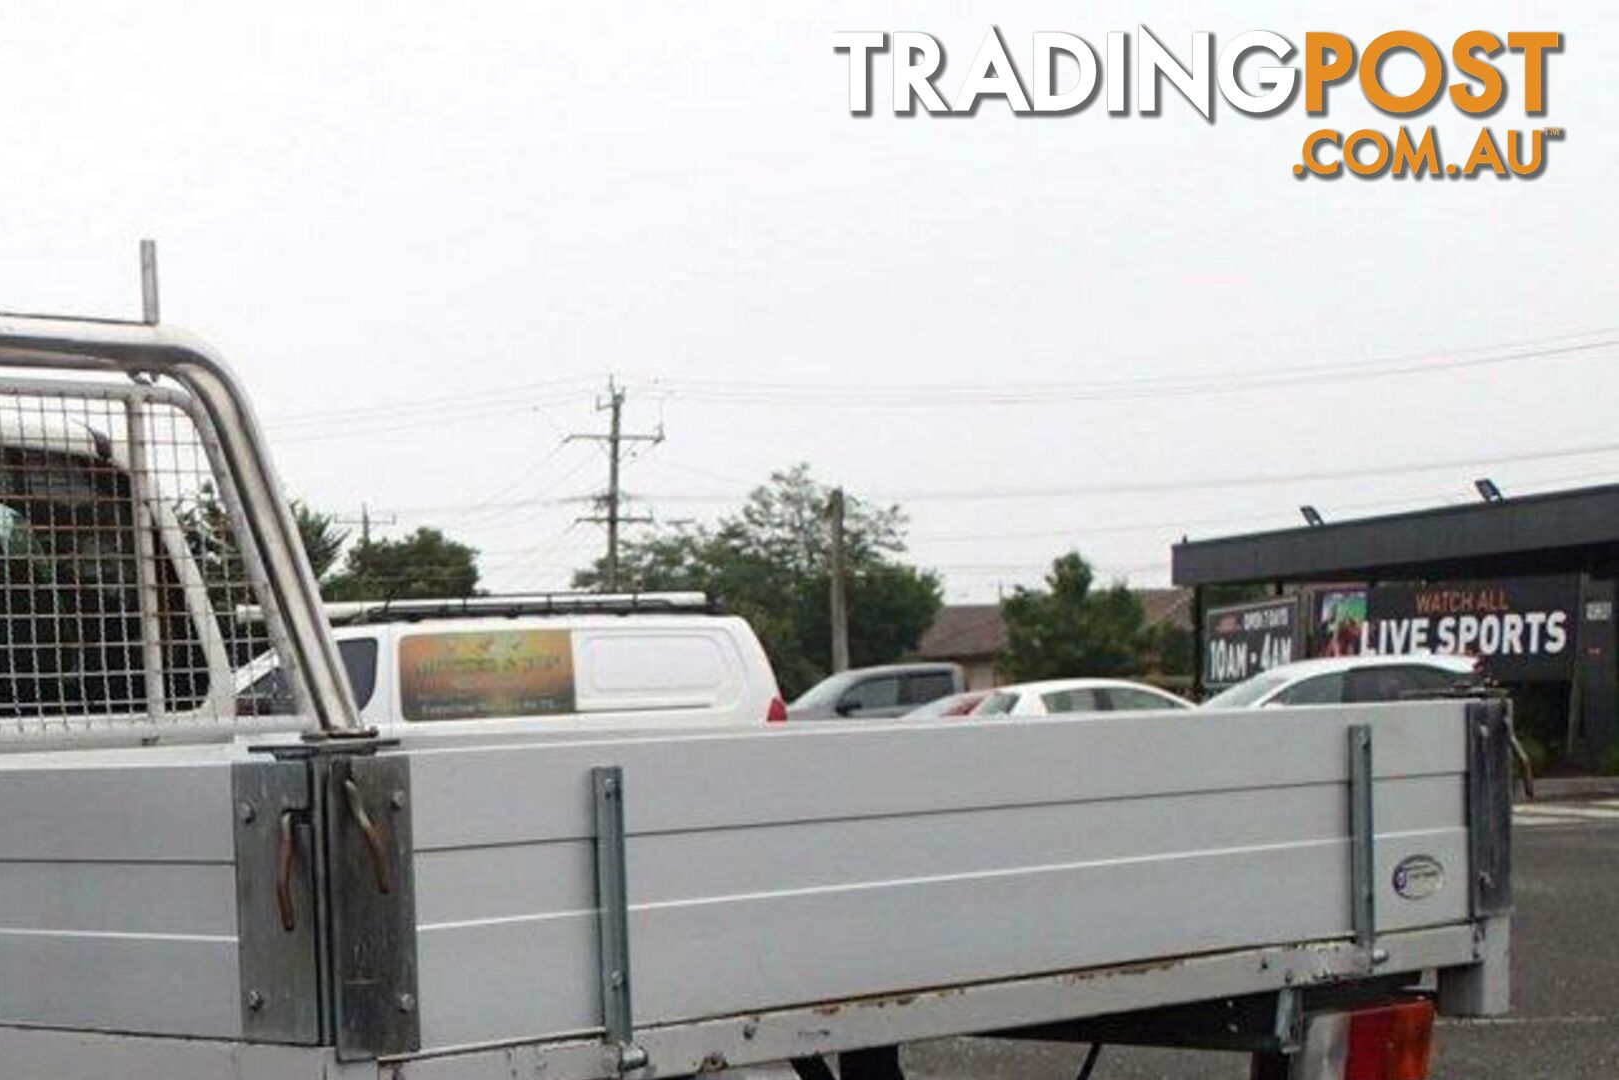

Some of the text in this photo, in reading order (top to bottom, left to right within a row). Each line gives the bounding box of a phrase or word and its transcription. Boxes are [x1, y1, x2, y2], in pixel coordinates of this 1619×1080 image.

[1415, 588, 1509, 616] WATCH ALL
[1360, 616, 1430, 656] LIVE
[1437, 610, 1567, 655] SPORTS
[1210, 638, 1248, 681] 10AM
[1260, 632, 1292, 671] 4AM
